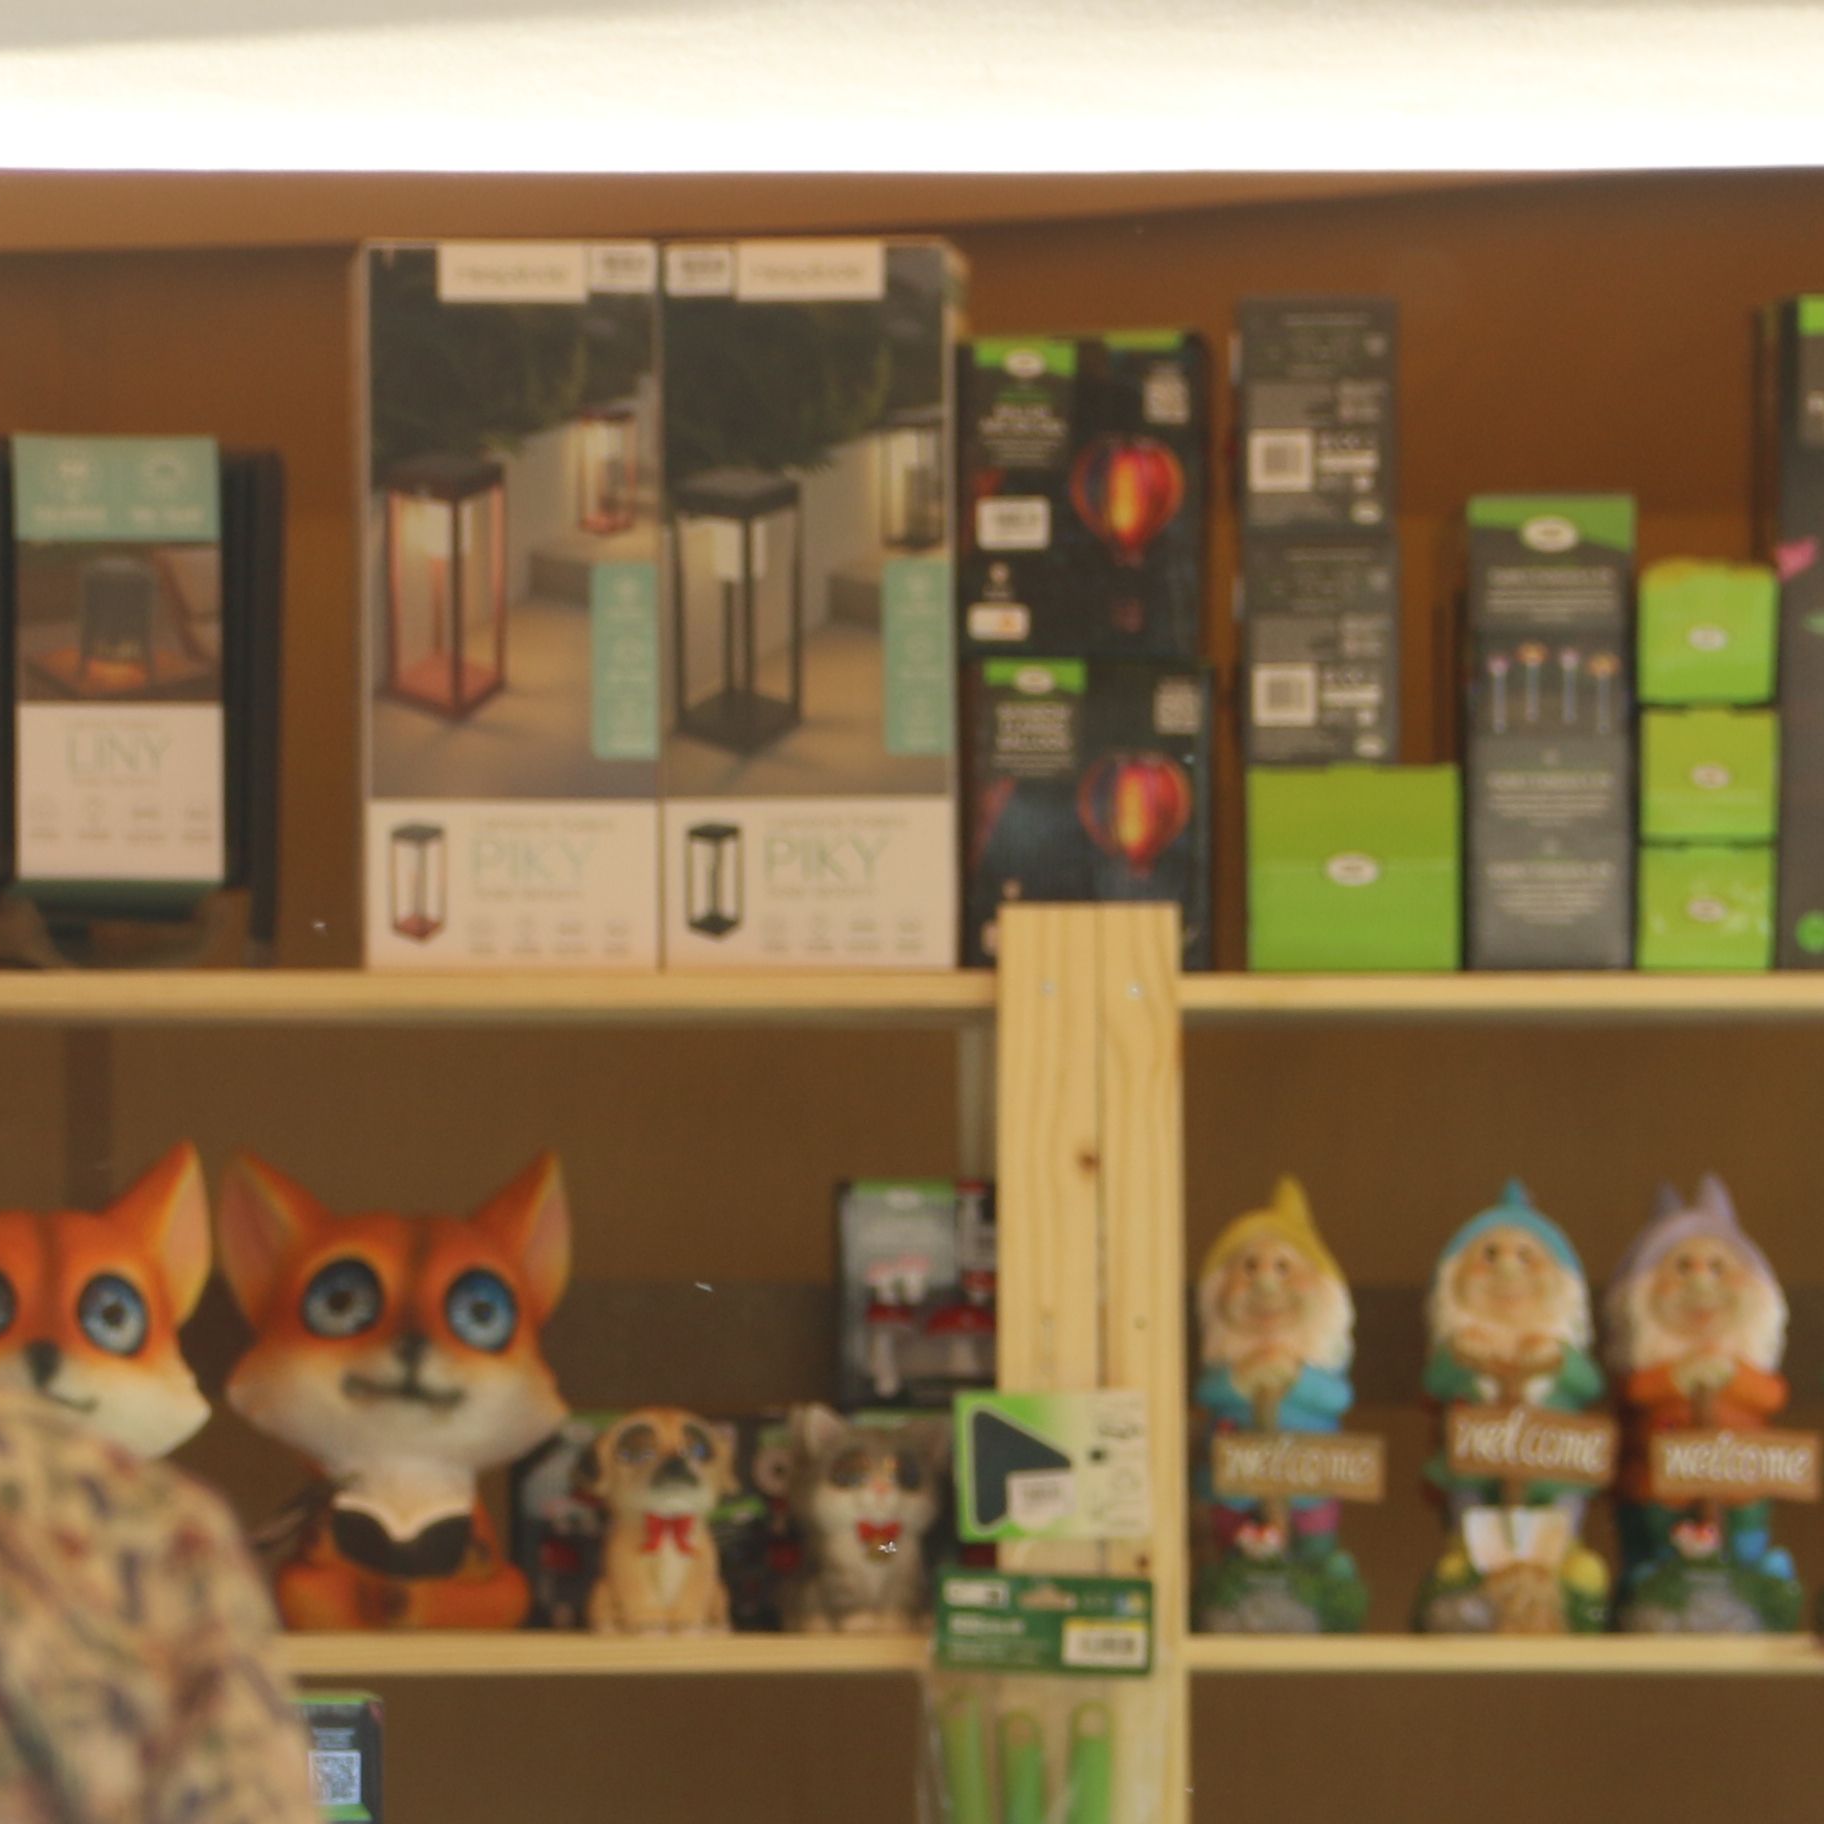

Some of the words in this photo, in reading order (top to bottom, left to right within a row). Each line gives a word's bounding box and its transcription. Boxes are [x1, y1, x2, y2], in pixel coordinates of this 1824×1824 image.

[471, 837, 595, 882] PIKY
[765, 835, 891, 881] PIKY
[1225, 1436, 1375, 1486] welcome
[1453, 1410, 1607, 1475] welcome
[1665, 1431, 1812, 1483] welcome
